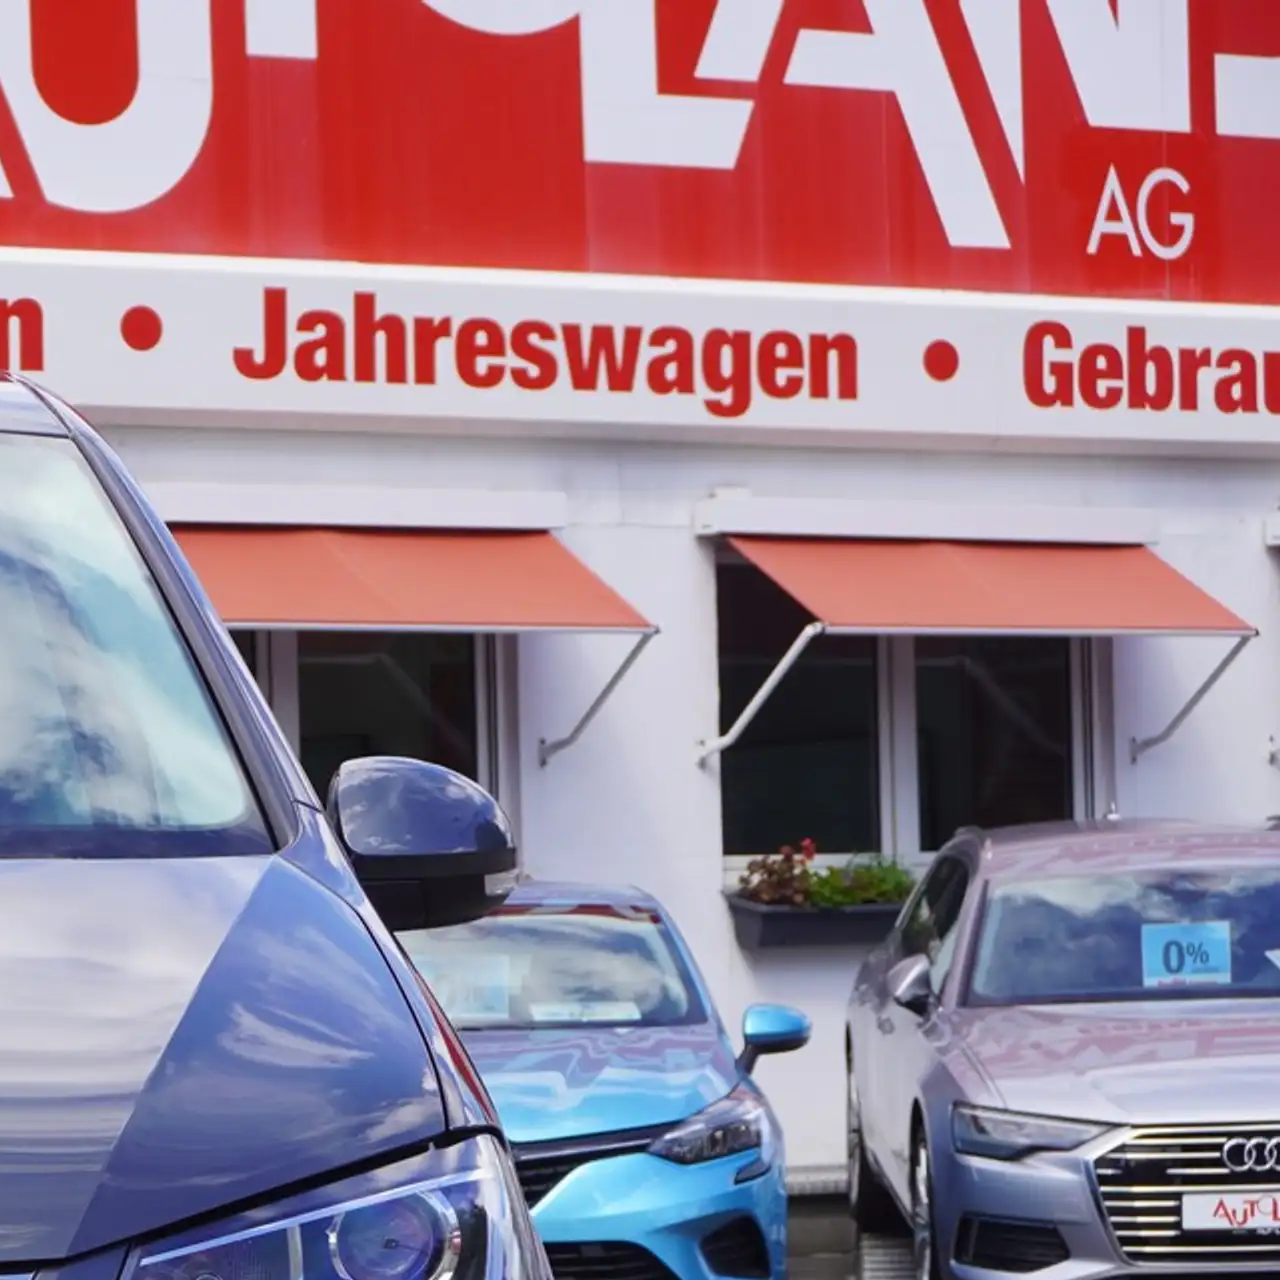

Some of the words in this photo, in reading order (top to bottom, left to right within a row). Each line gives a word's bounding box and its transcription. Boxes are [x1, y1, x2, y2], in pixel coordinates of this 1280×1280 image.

[1085, 165, 1196, 261] AG
[232, 286, 859, 418] Jahreswagen
[1022, 319, 1280, 416] Gebra
[1162, 939, 1210, 974] 0%
